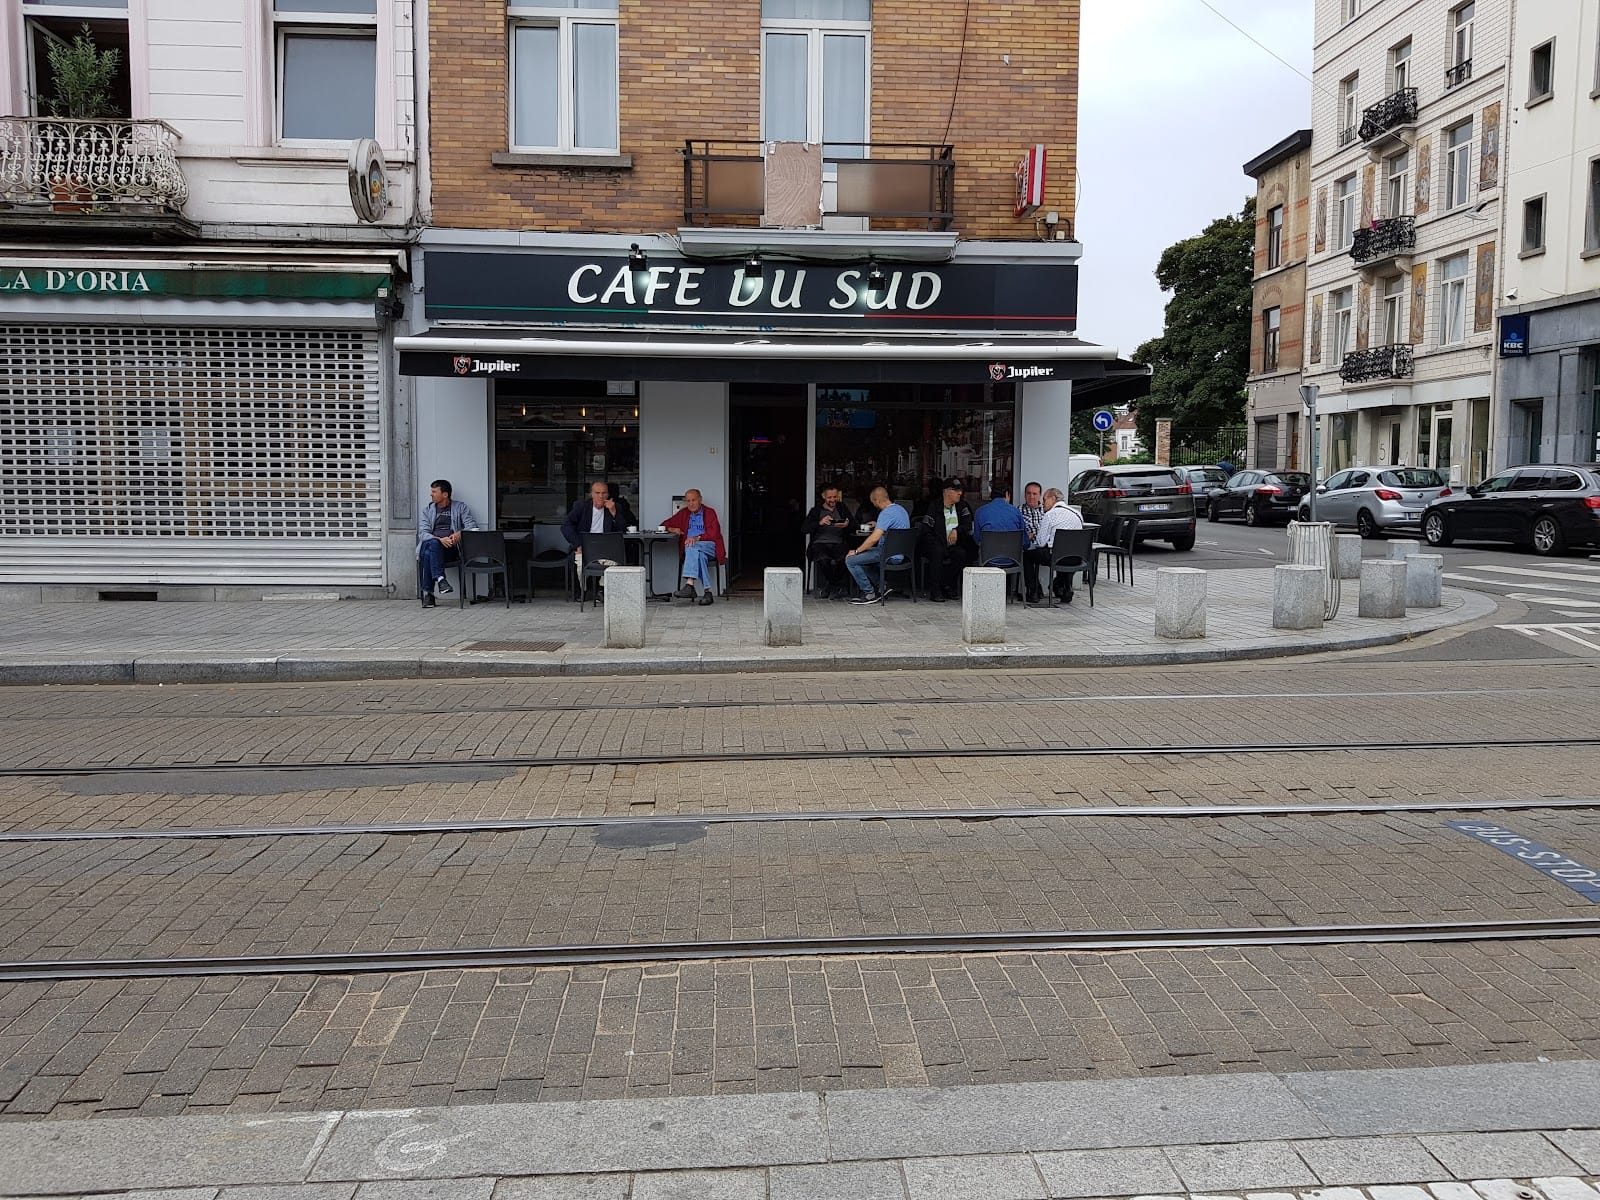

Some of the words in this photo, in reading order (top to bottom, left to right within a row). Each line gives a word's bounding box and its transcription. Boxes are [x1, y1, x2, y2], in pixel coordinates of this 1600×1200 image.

[45, 269, 151, 292] D'ORIA
[567, 264, 706, 306] CAFE
[728, 269, 808, 309] DU
[828, 270, 943, 310] SUD
[1379, 443, 1387, 461] 5
